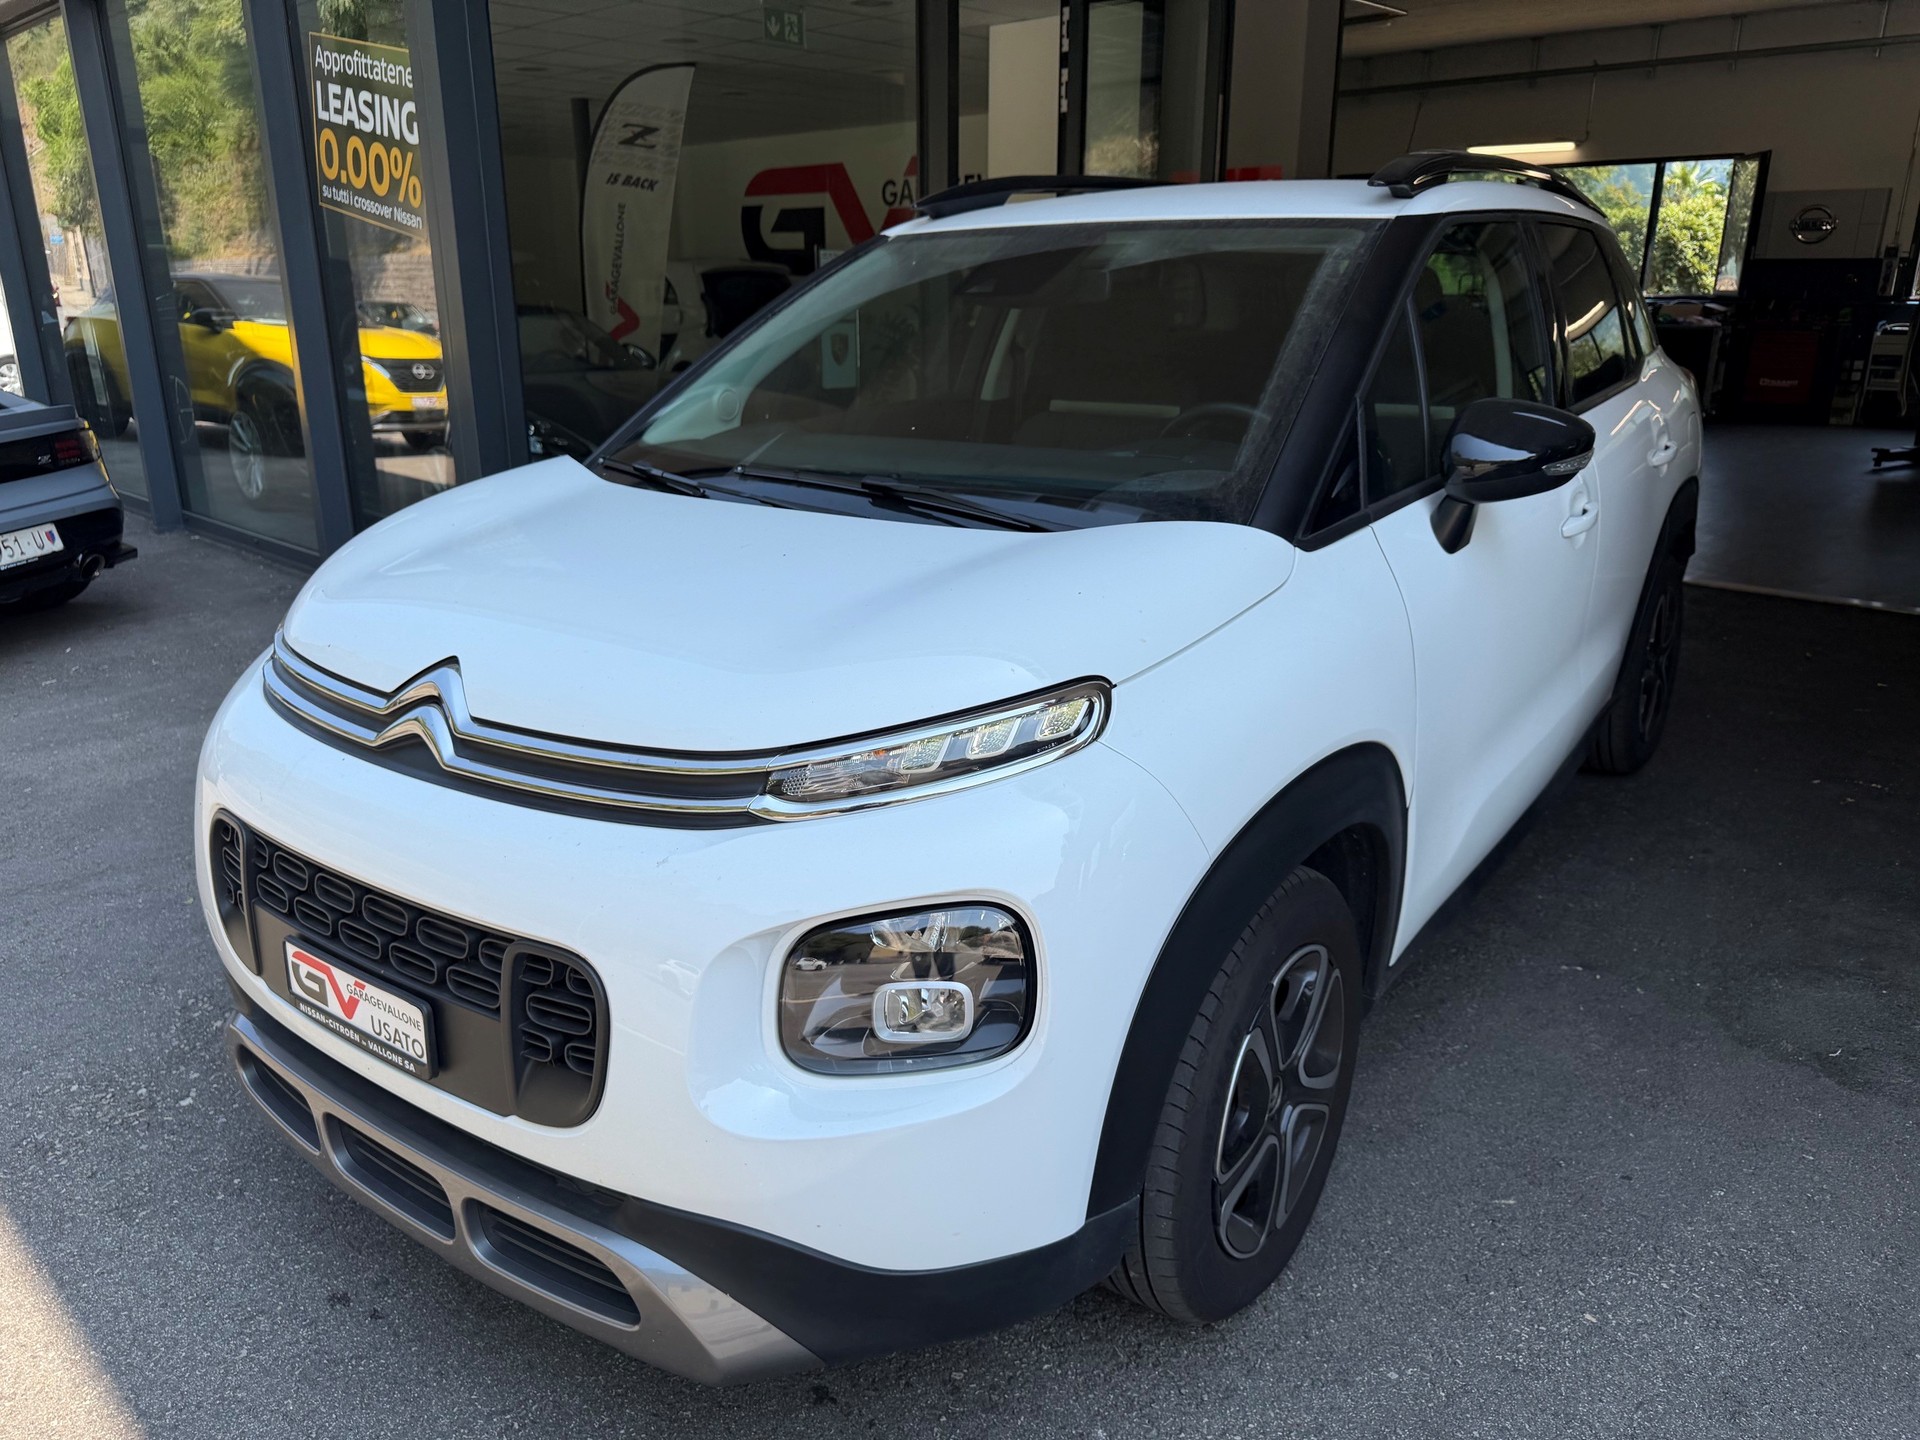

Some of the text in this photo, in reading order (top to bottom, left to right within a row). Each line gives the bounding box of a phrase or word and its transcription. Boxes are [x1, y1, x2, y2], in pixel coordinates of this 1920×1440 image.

[315, 44, 414, 89] Approfittatene
[316, 80, 420, 145] LEASING
[319, 127, 422, 208] 0.00%
[606, 172, 659, 192] IS BACK
[322, 184, 332, 198] su
[332, 186, 349, 205] tutti
[354, 195, 392, 219] crossover
[394, 206, 423, 230] Nissan
[346, 983, 422, 1032] GARAGEVALLONE
[367, 1040, 403, 1065] VALLONE
[404, 1060, 416, 1073] SA
[370, 1014, 425, 1060] USATO
